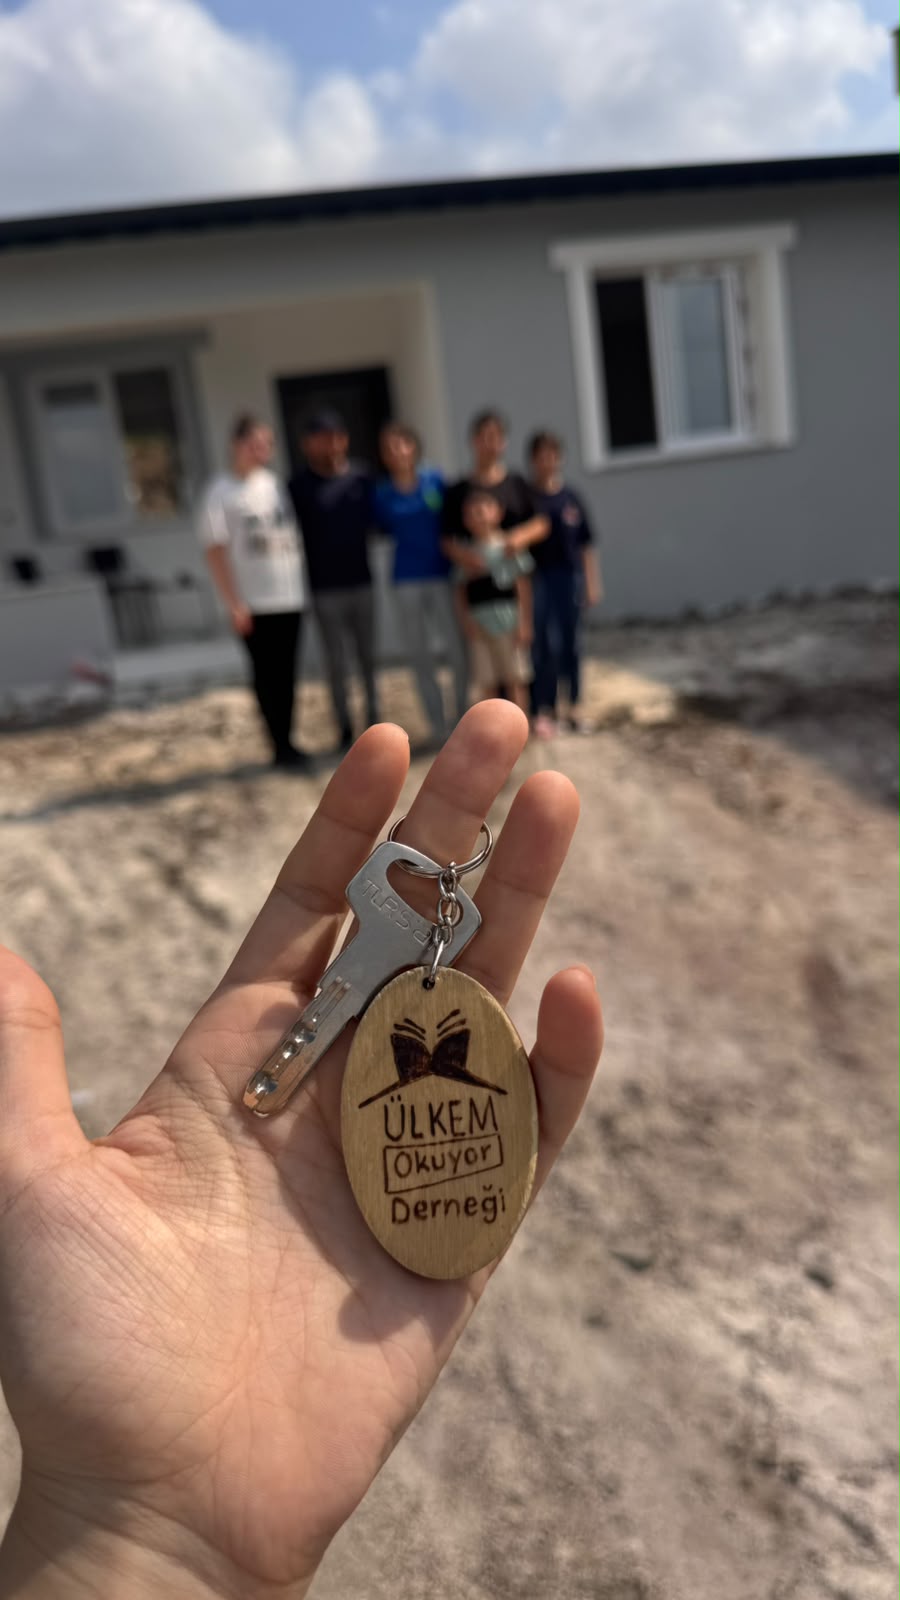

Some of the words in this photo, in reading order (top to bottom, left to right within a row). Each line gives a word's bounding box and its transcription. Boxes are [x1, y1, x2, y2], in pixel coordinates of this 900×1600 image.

[383, 1095, 498, 1142] ÜLKEM
[393, 1142, 493, 1178] Okuyor
[390, 1184, 507, 1225] Derneği
